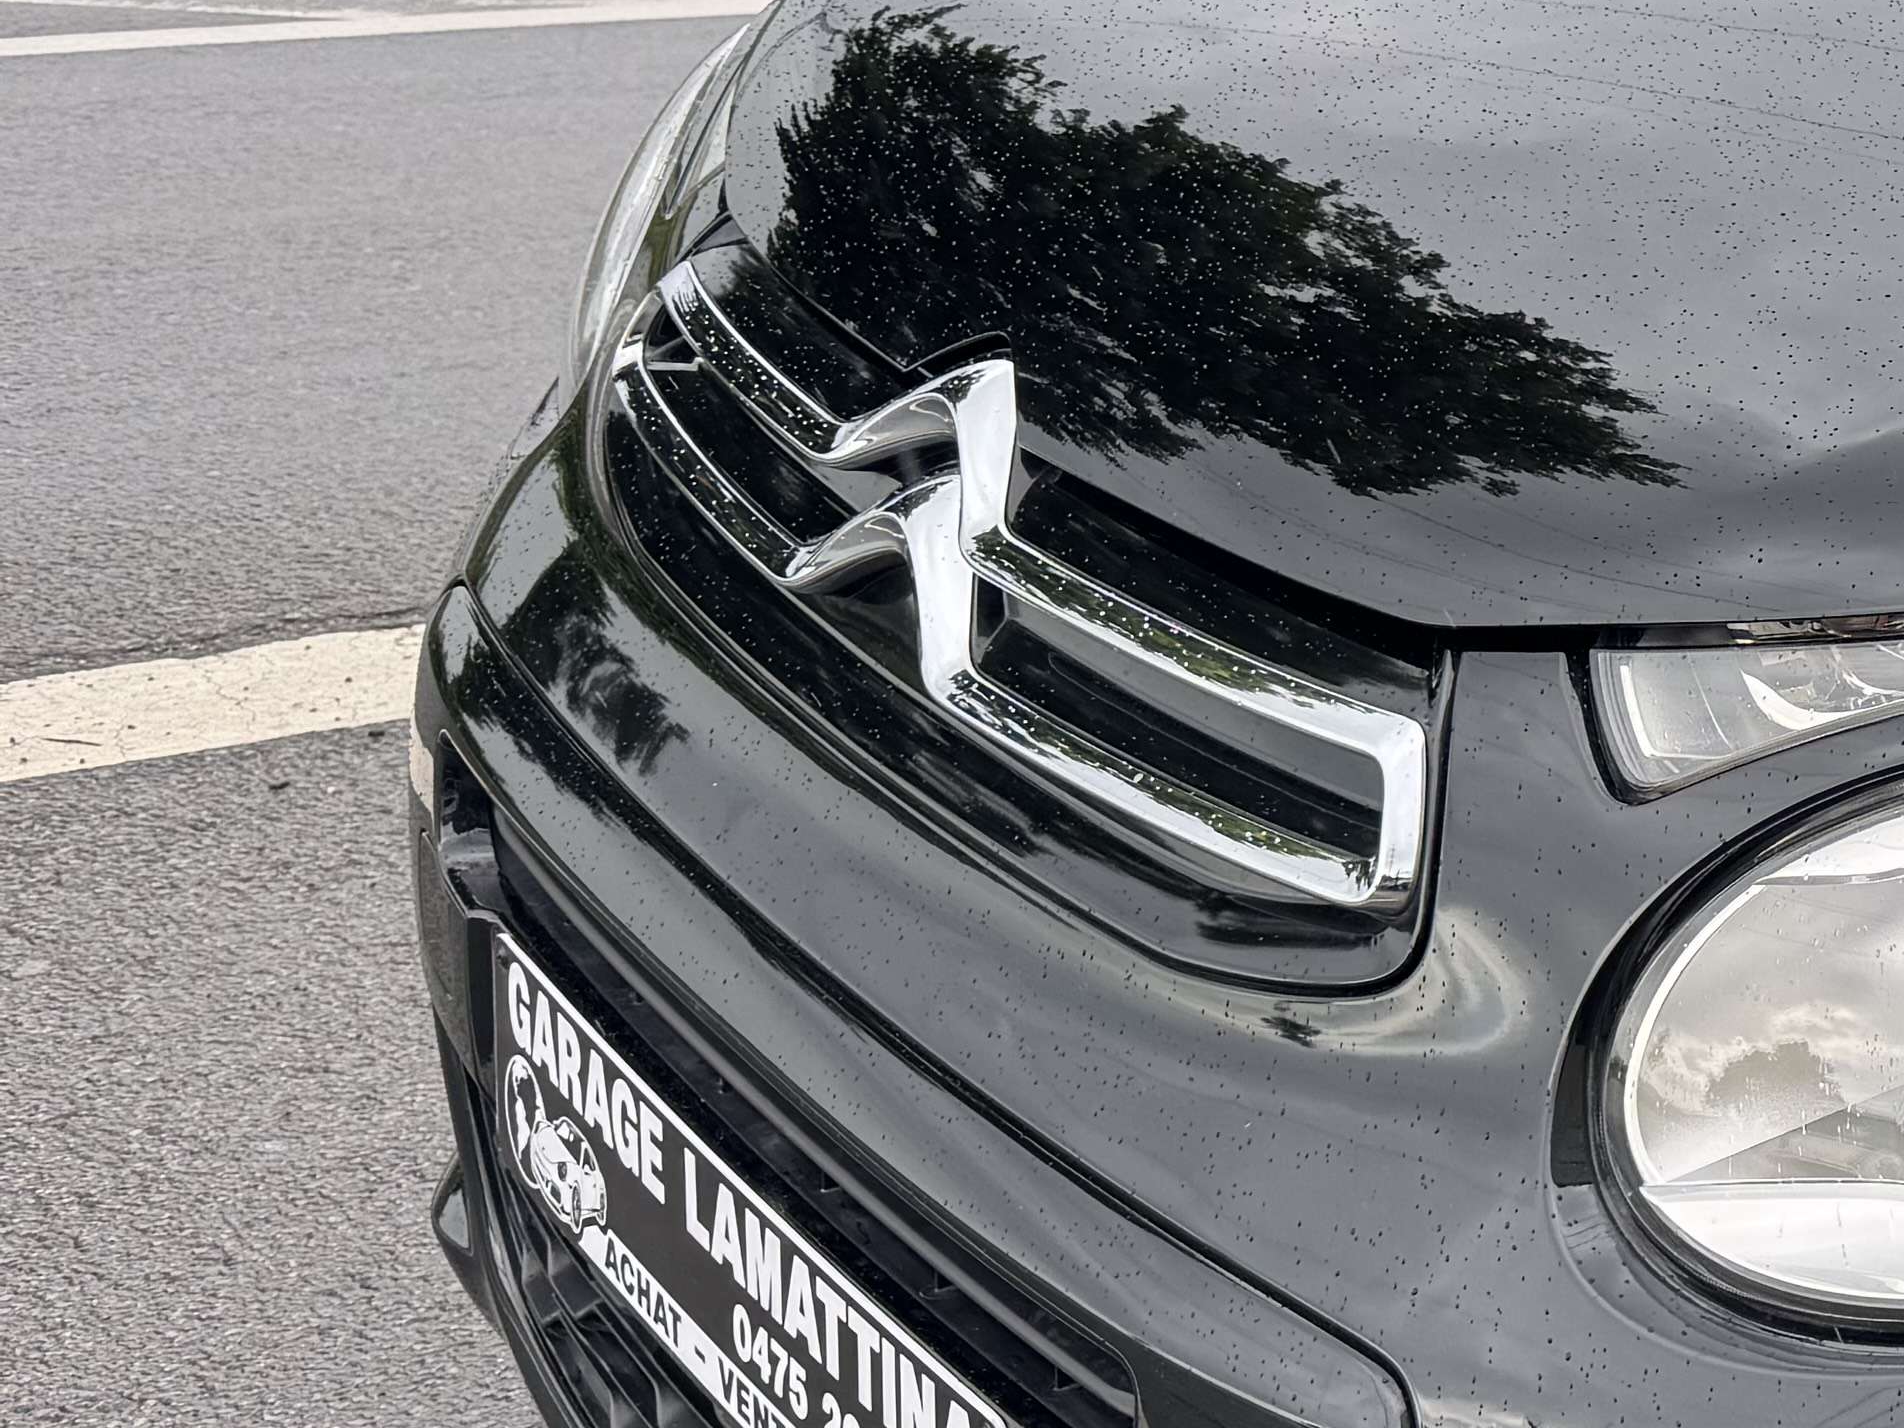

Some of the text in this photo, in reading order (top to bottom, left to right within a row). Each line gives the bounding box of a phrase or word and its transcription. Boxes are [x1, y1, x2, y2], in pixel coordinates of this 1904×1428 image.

[507, 960, 667, 1206] GARAGE
[603, 1237, 683, 1348] ACHAT
[732, 1302, 810, 1421] 0475
